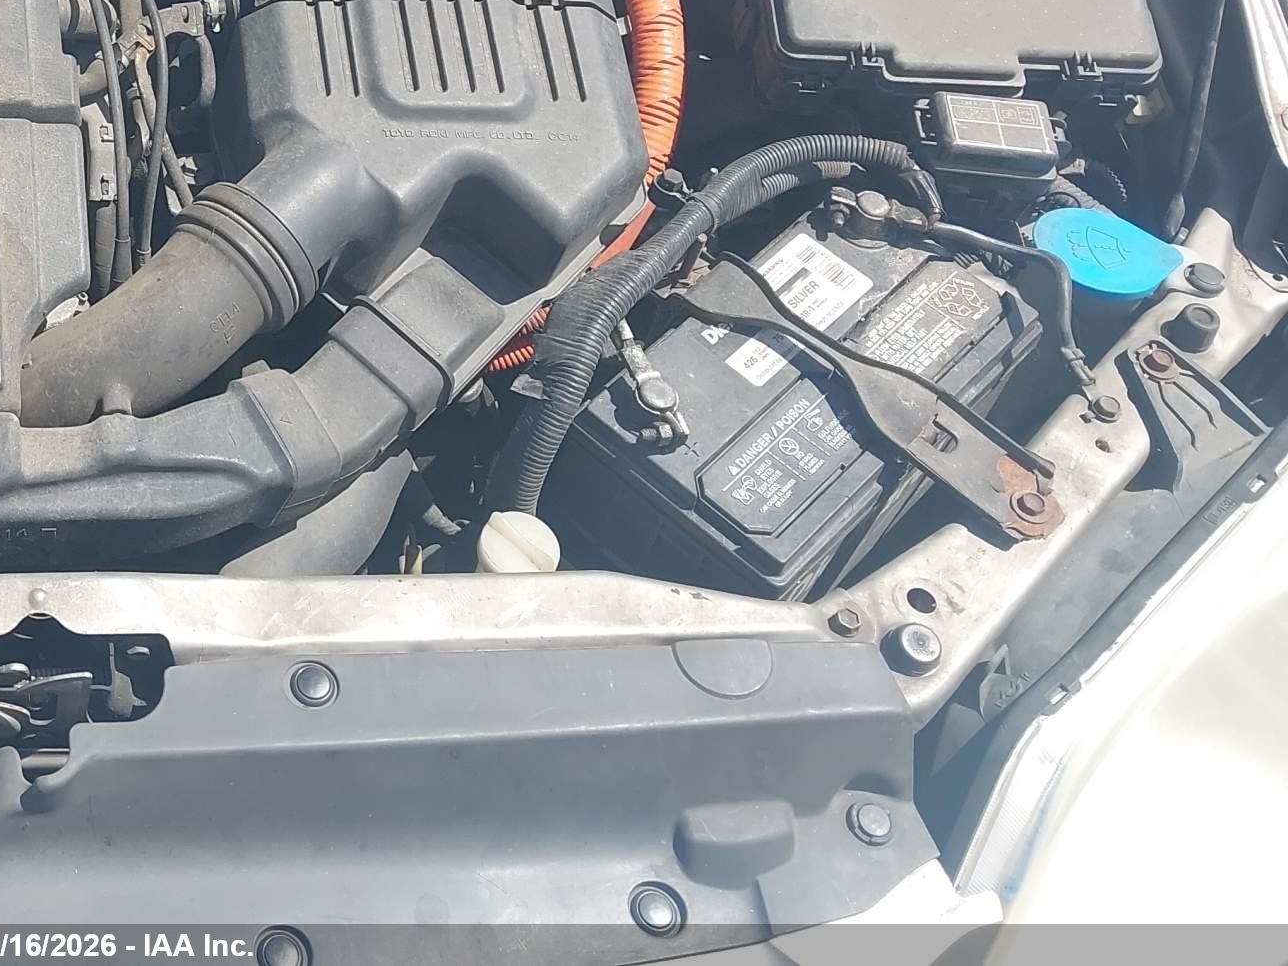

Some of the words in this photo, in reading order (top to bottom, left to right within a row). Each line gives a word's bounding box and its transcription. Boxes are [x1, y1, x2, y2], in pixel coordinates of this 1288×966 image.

[789, 280, 819, 309] SILVER
[734, 431, 775, 468] DANGER
[776, 398, 810, 431] POISON
